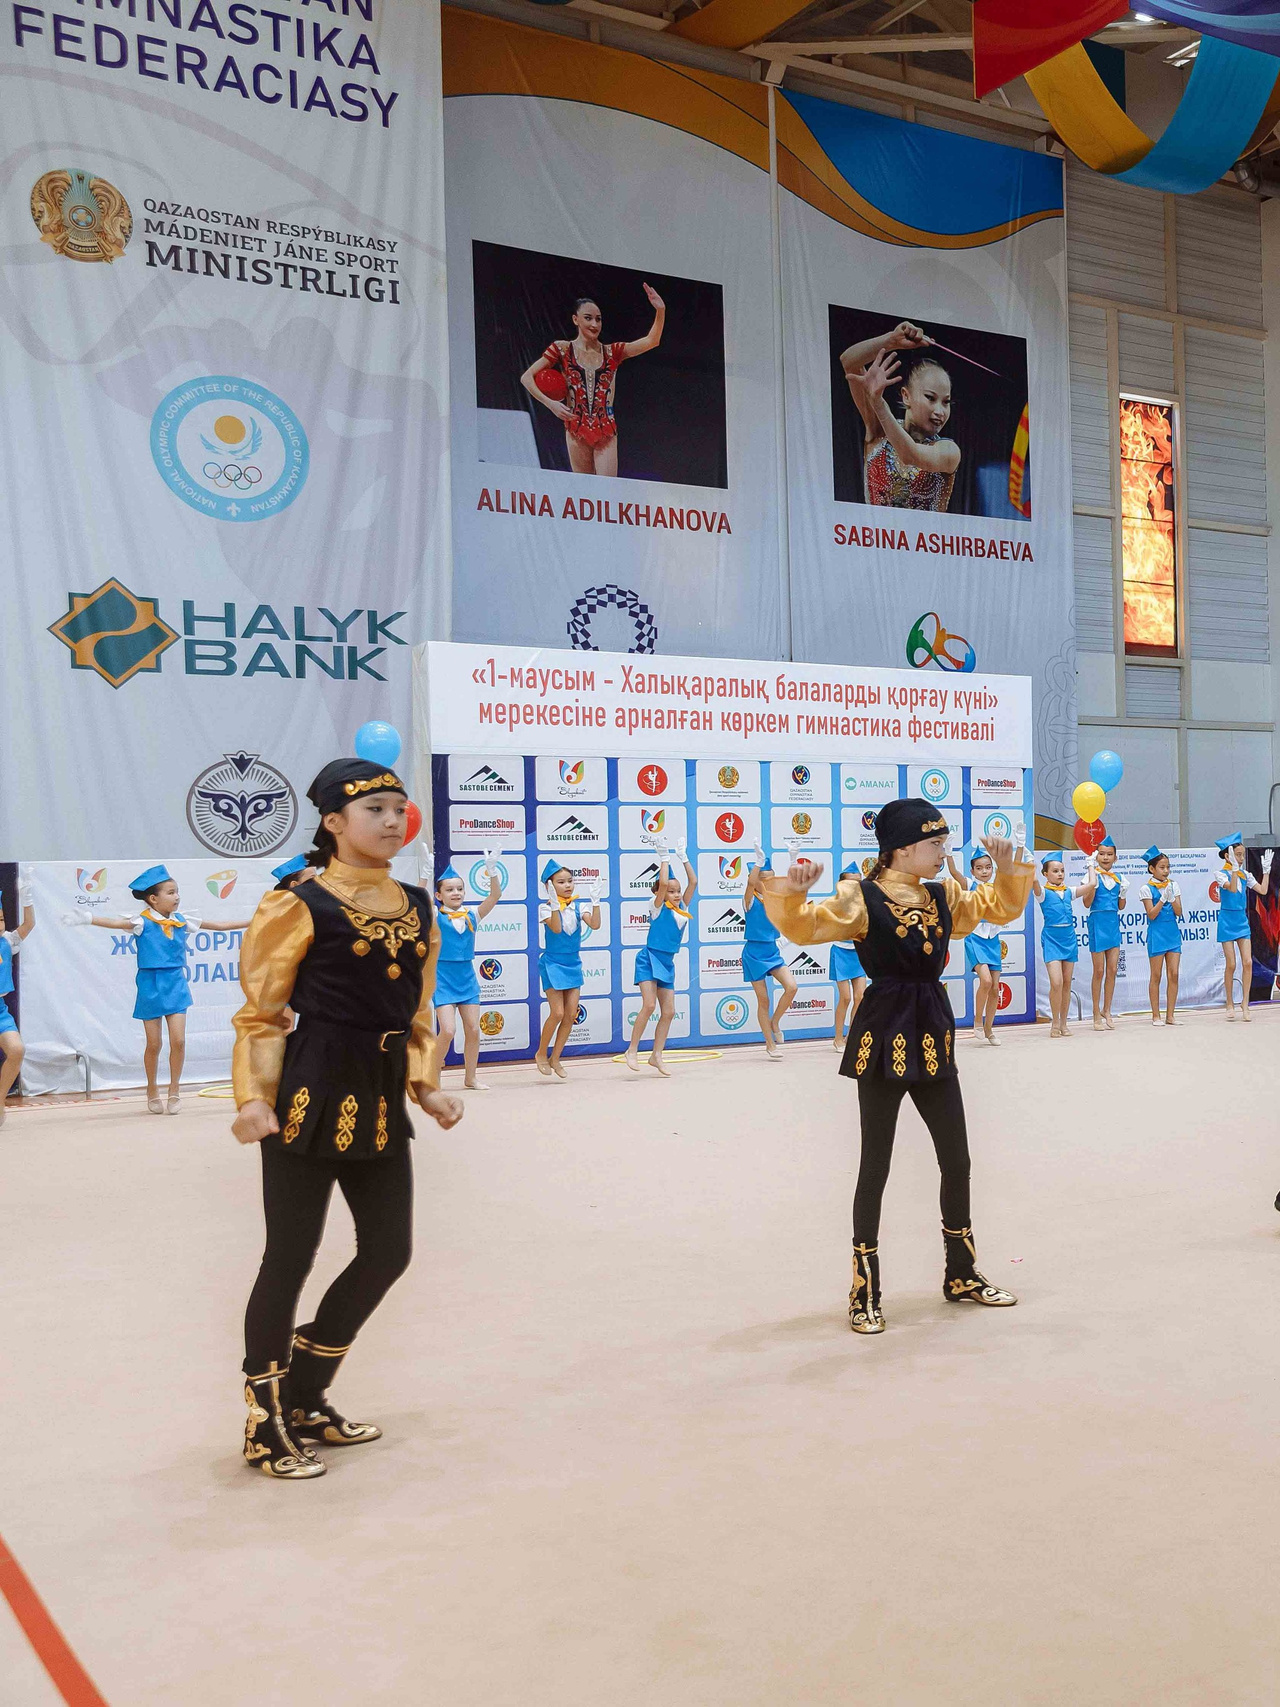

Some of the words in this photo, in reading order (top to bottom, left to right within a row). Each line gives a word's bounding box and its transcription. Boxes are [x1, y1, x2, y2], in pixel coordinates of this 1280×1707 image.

[13, 3, 399, 128] FEDERACIASY
[144, 198, 260, 231] QAZAQSTAN
[266, 220, 398, 253] RESPÝBLIKASY
[144, 218, 267, 253] MÁDENIET
[273, 239, 328, 264] JÁNE
[334, 251, 399, 274] SPORT
[145, 240, 400, 305] MINISTRLIGI
[165, 383, 221, 419] COMMITTEE
[223, 383, 240, 393] OF
[242, 387, 264, 403] THE
[158, 420, 174, 467] OLYMPIC
[264, 399, 301, 447] REPUBLIC
[293, 449, 302, 464] OF
[170, 468, 218, 510] NATIONAL
[250, 463, 302, 513] KAZAKHSTAN
[477, 487, 556, 519] ALINA
[561, 501, 732, 535] ADILKHANOVA
[834, 523, 910, 552] SABINA
[914, 531, 1034, 563] ASHIRBAEVA
[183, 599, 409, 645] HALYK
[184, 638, 390, 682] BANK
[471, 658, 596, 697] «1-маусым
[620, 664, 770, 704] Халықаралық
[775, 673, 881, 711] балаларды
[887, 686, 949, 715] қорғау
[953, 686, 999, 716] күні»
[479, 698, 607, 732] мерекесіне
[614, 705, 713, 735] арналған
[721, 711, 789, 739] көркем
[796, 713, 902, 738] гимнастика
[907, 715, 995, 743] фестивалі
[859, 780, 895, 788] AMANAT
[977, 778, 1017, 789] ProDanceShop
[459, 819, 515, 830] ProDanceShop
